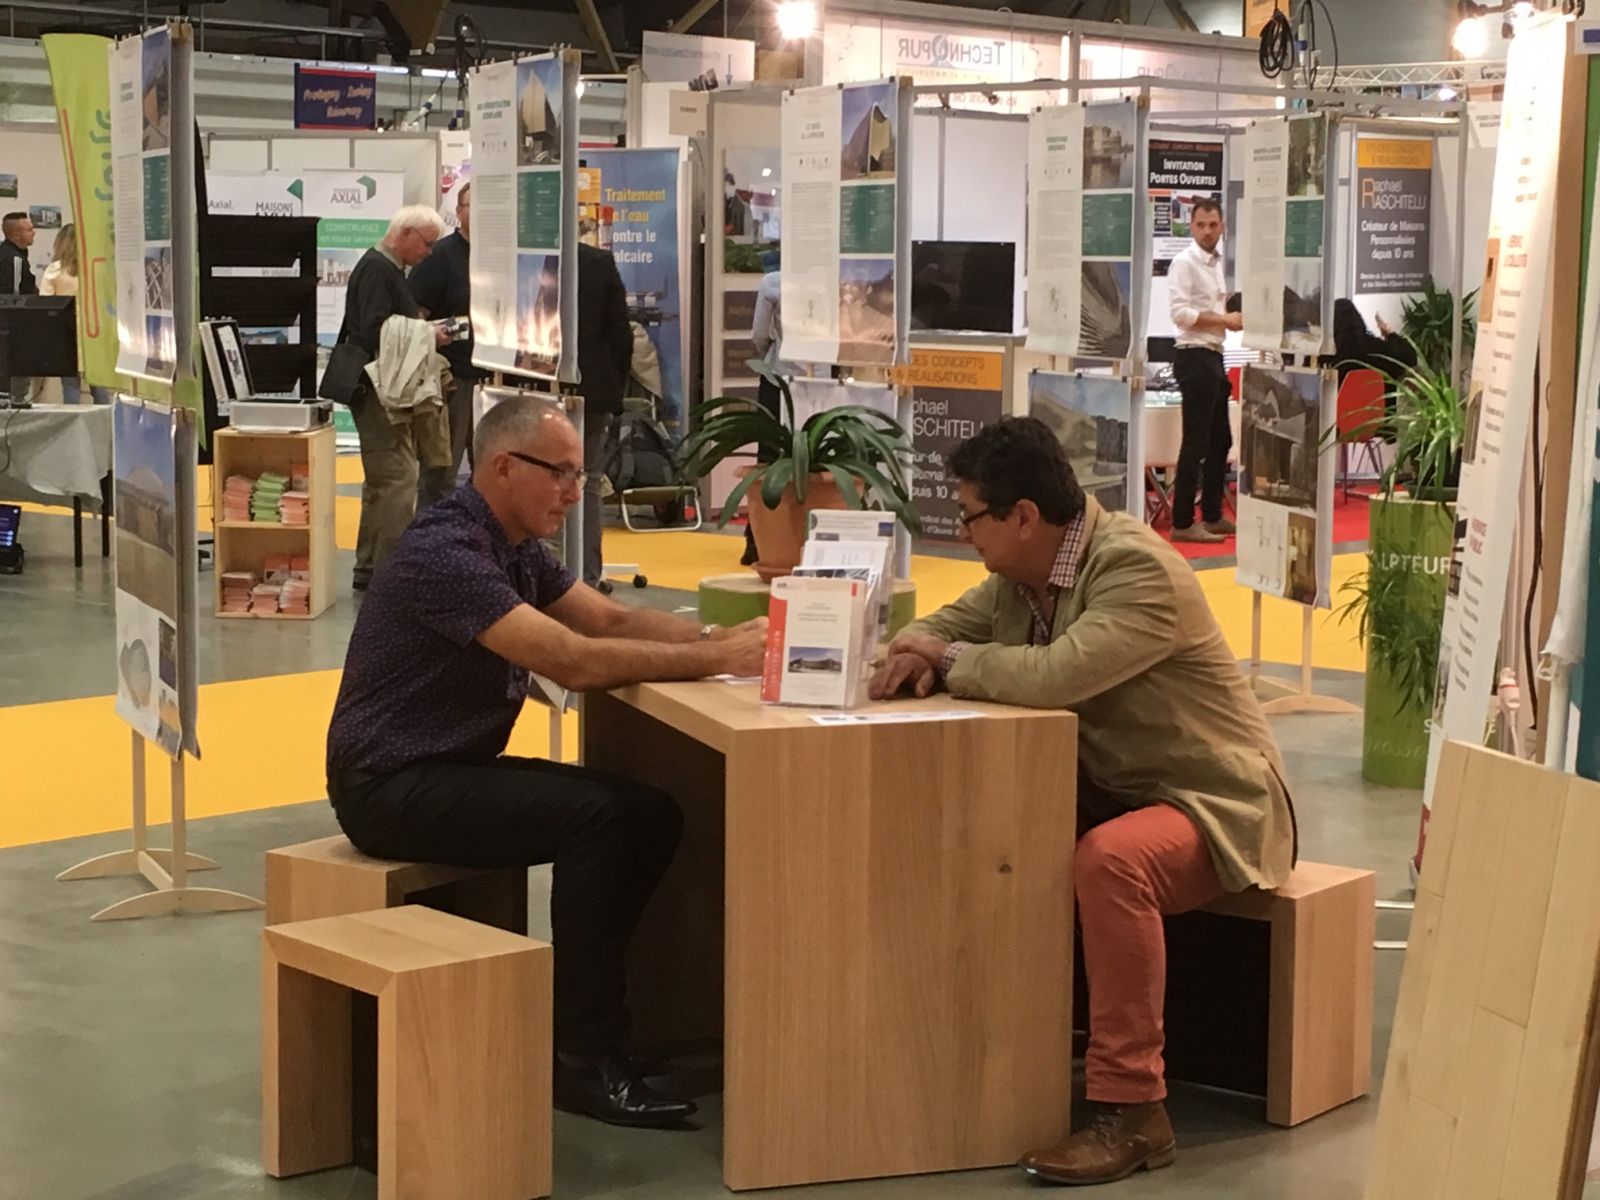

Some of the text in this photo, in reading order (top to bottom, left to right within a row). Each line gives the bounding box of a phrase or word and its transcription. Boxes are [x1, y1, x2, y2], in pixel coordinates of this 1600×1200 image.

[1163, 159, 1205, 171] INVITATION
[1150, 172, 1217, 185] PORTES OUVERTES
[330, 192, 363, 204] AXIAL
[604, 188, 666, 202] Traitement
[255, 202, 294, 213] MAISONS
[1389, 221, 1398, 231] de
[646, 228, 657, 242] le
[613, 248, 654, 263] alcaire
[931, 355, 985, 370] CONCEPTS
[935, 485, 948, 499] 10
